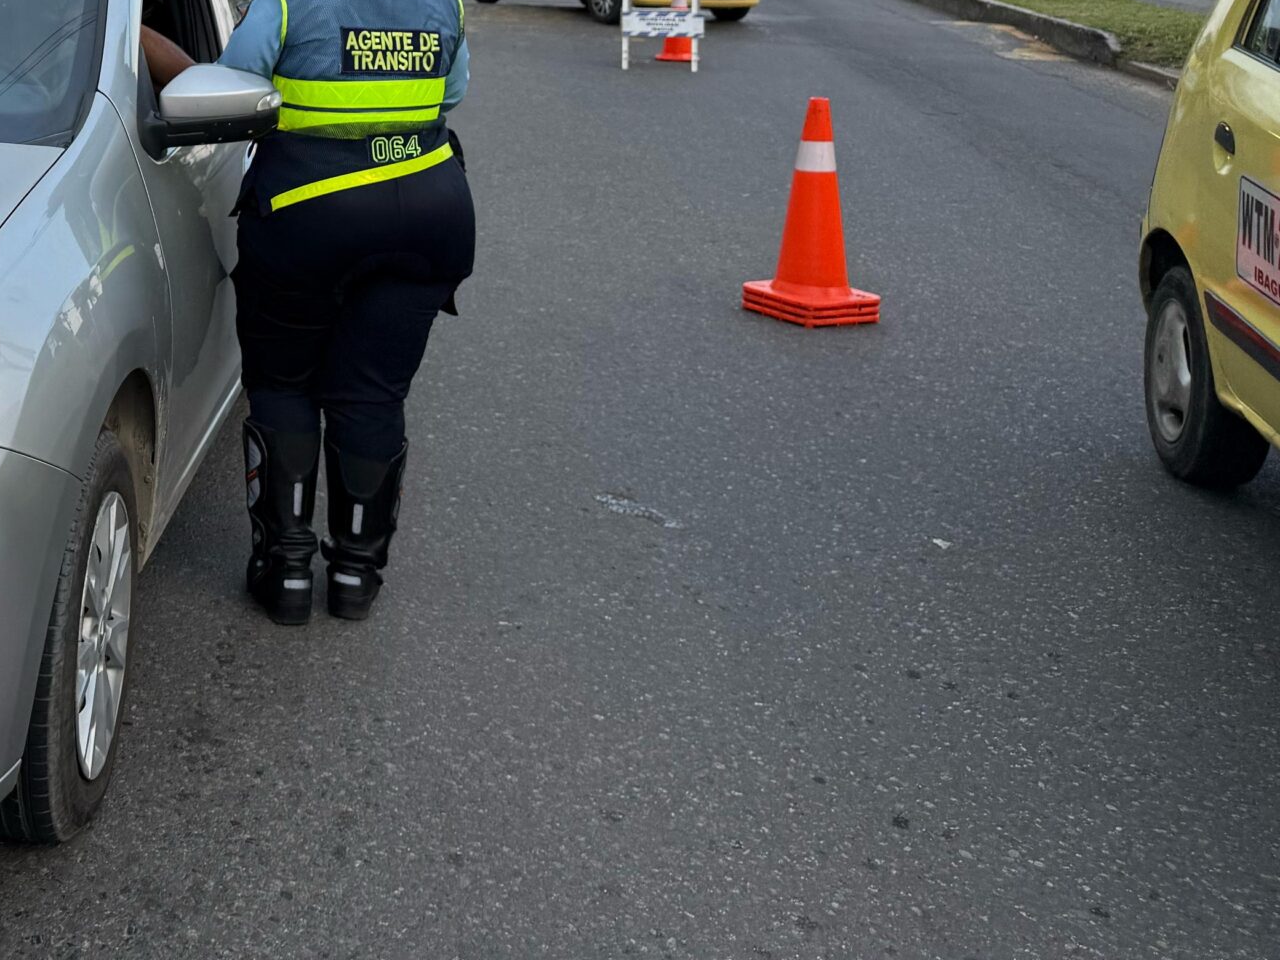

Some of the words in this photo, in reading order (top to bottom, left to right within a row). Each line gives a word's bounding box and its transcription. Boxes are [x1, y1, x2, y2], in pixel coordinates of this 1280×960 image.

[346, 30, 412, 51] AGENTE
[419, 32, 440, 52] DE
[351, 50, 435, 72] TRANSITO
[372, 135, 422, 163] 064
[1254, 265, 1280, 298] IBAG
